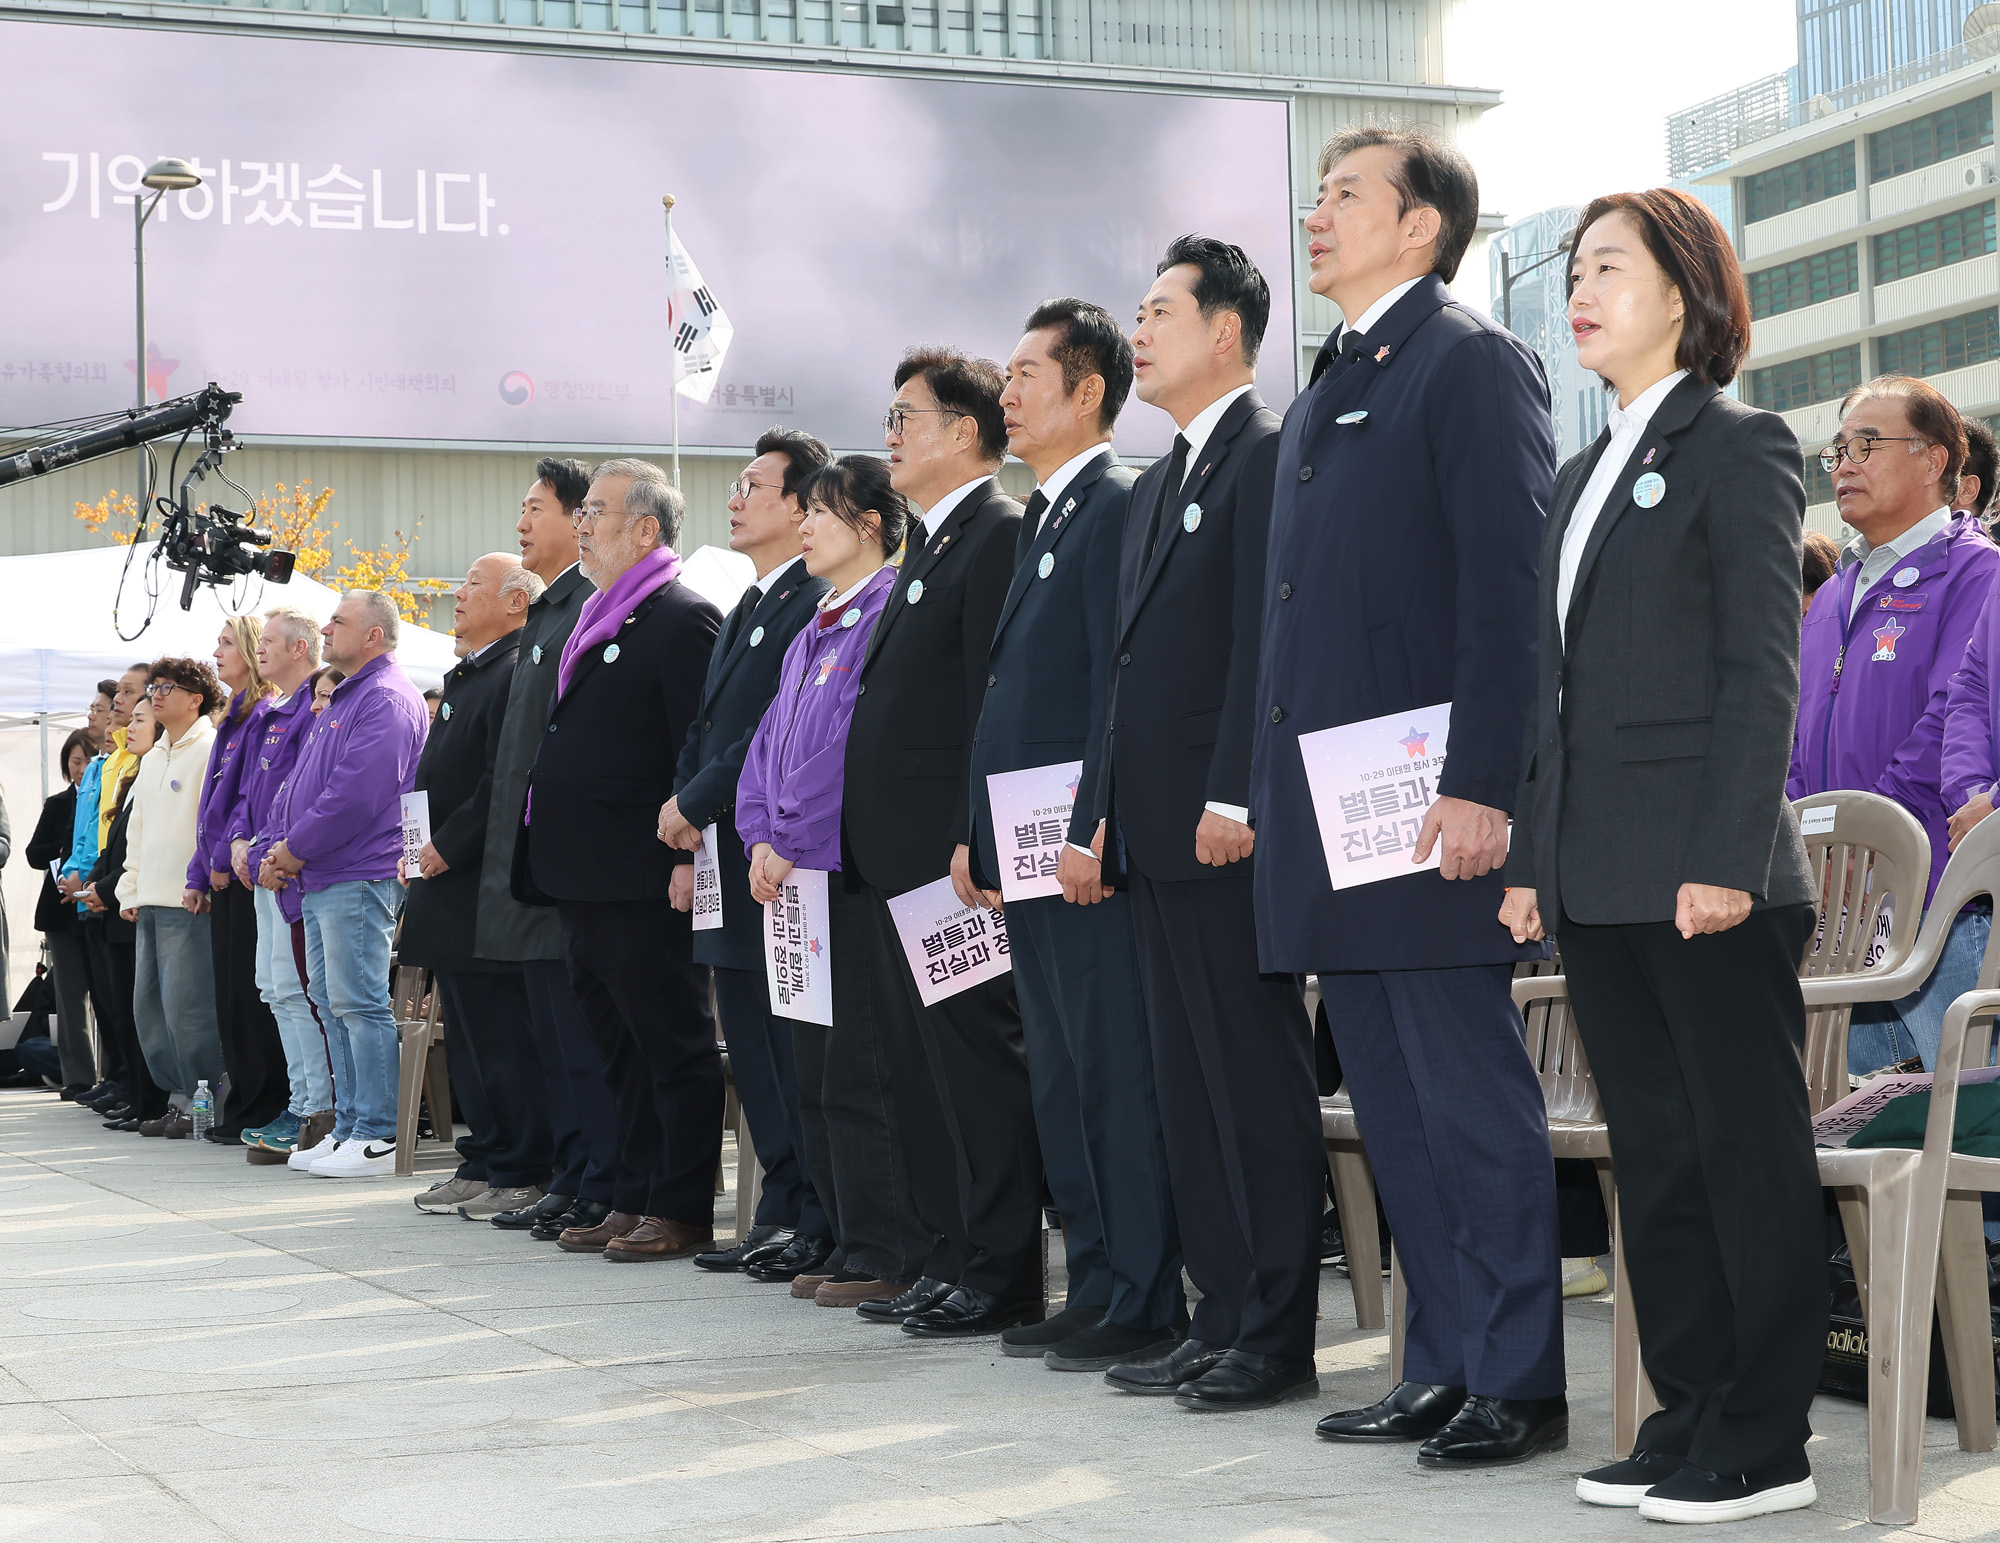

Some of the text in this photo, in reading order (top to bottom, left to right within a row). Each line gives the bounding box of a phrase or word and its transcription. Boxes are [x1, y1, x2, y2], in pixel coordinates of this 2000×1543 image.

[42, 152, 509, 236] 기억하겠습니다.
[1, 360, 106, 383] 유가족협의회
[544, 381, 631, 401] 행정안전부
[1360, 770, 1384, 782] 10·29
[1386, 763, 1411, 777] 이태원
[1431, 756, 1445, 766] 3주
[1033, 808, 1052, 816] 10·29
[1338, 777, 1430, 824] 별들과
[1013, 850, 1060, 880] 진실
[921, 914, 986, 958] 별들과
[935, 915, 953, 926] 10·29
[786, 885, 804, 997] 별들과 함께,
[774, 945, 790, 1005] 정의로
[925, 941, 990, 985] 진실과
